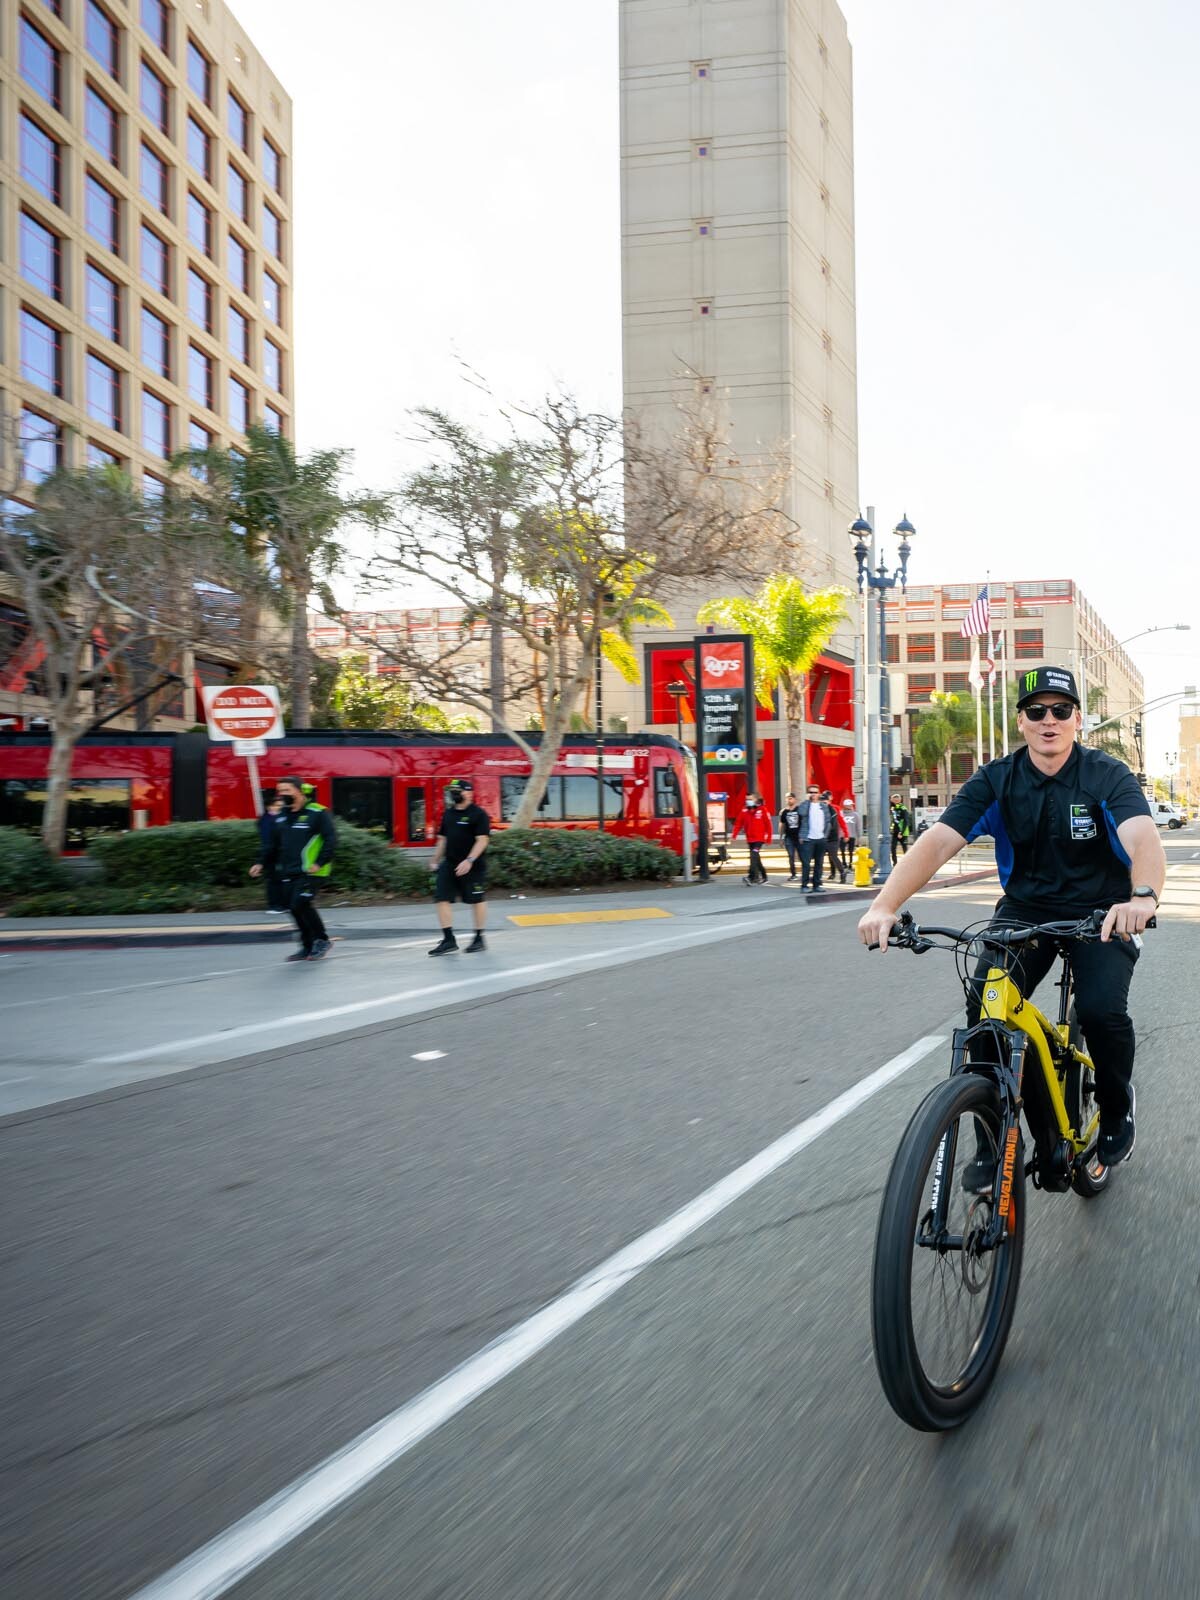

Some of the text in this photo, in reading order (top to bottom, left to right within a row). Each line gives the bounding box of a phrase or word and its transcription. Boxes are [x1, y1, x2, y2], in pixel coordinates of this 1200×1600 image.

[215, 696, 267, 705] DO NOT
[704, 695, 723, 703] 12th
[704, 704, 738, 713] Imperial
[704, 715, 732, 723] Transit
[222, 720, 270, 729] ENTER
[704, 725, 732, 733] Center
[998, 1142, 1017, 1216] REVELATION
